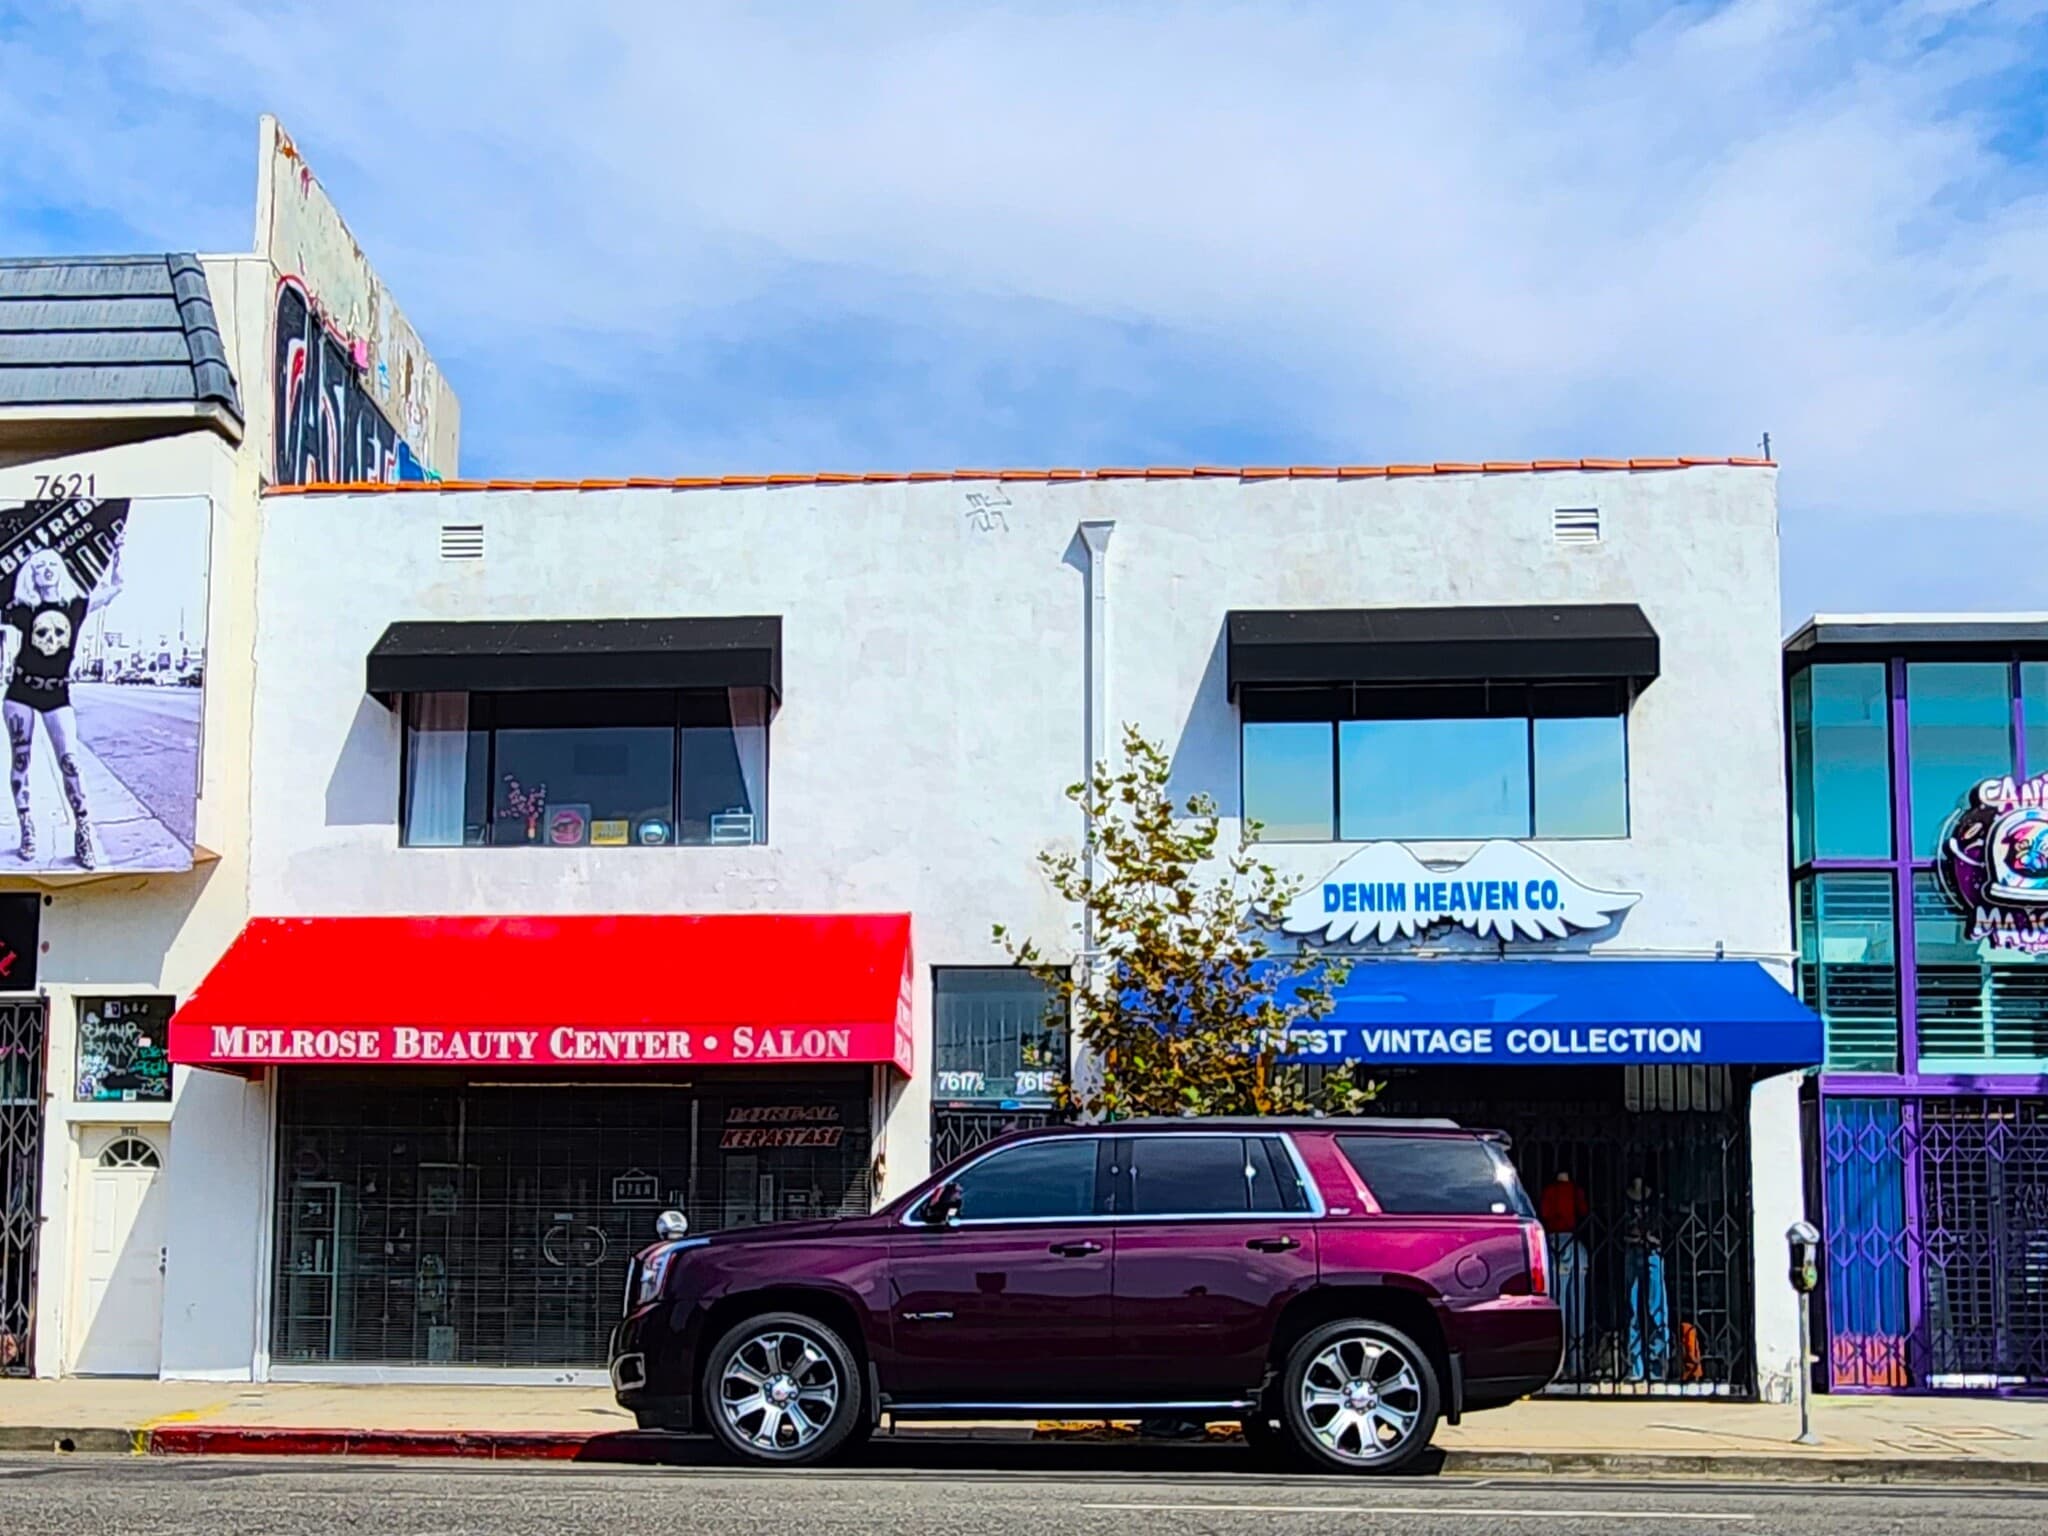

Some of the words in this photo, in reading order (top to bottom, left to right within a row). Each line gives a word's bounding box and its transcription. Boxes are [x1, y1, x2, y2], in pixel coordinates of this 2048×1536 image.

[34, 473, 95, 500] 7621
[0, 539, 43, 582] BEL
[1978, 775, 2048, 813] CAN
[1323, 882, 1406, 913] DENIM
[1414, 881, 1519, 912] HEAVEN
[1525, 879, 1565, 912] CO.
[210, 1025, 380, 1058] MELROSE
[392, 1026, 539, 1059] BEAUTY
[549, 1026, 692, 1060] CENTER
[732, 1026, 851, 1059] SALON
[1361, 1029, 1492, 1053] VINTAGE
[1506, 1028, 1702, 1053] COLLECTION
[718, 1126, 845, 1149] KERASTASE
